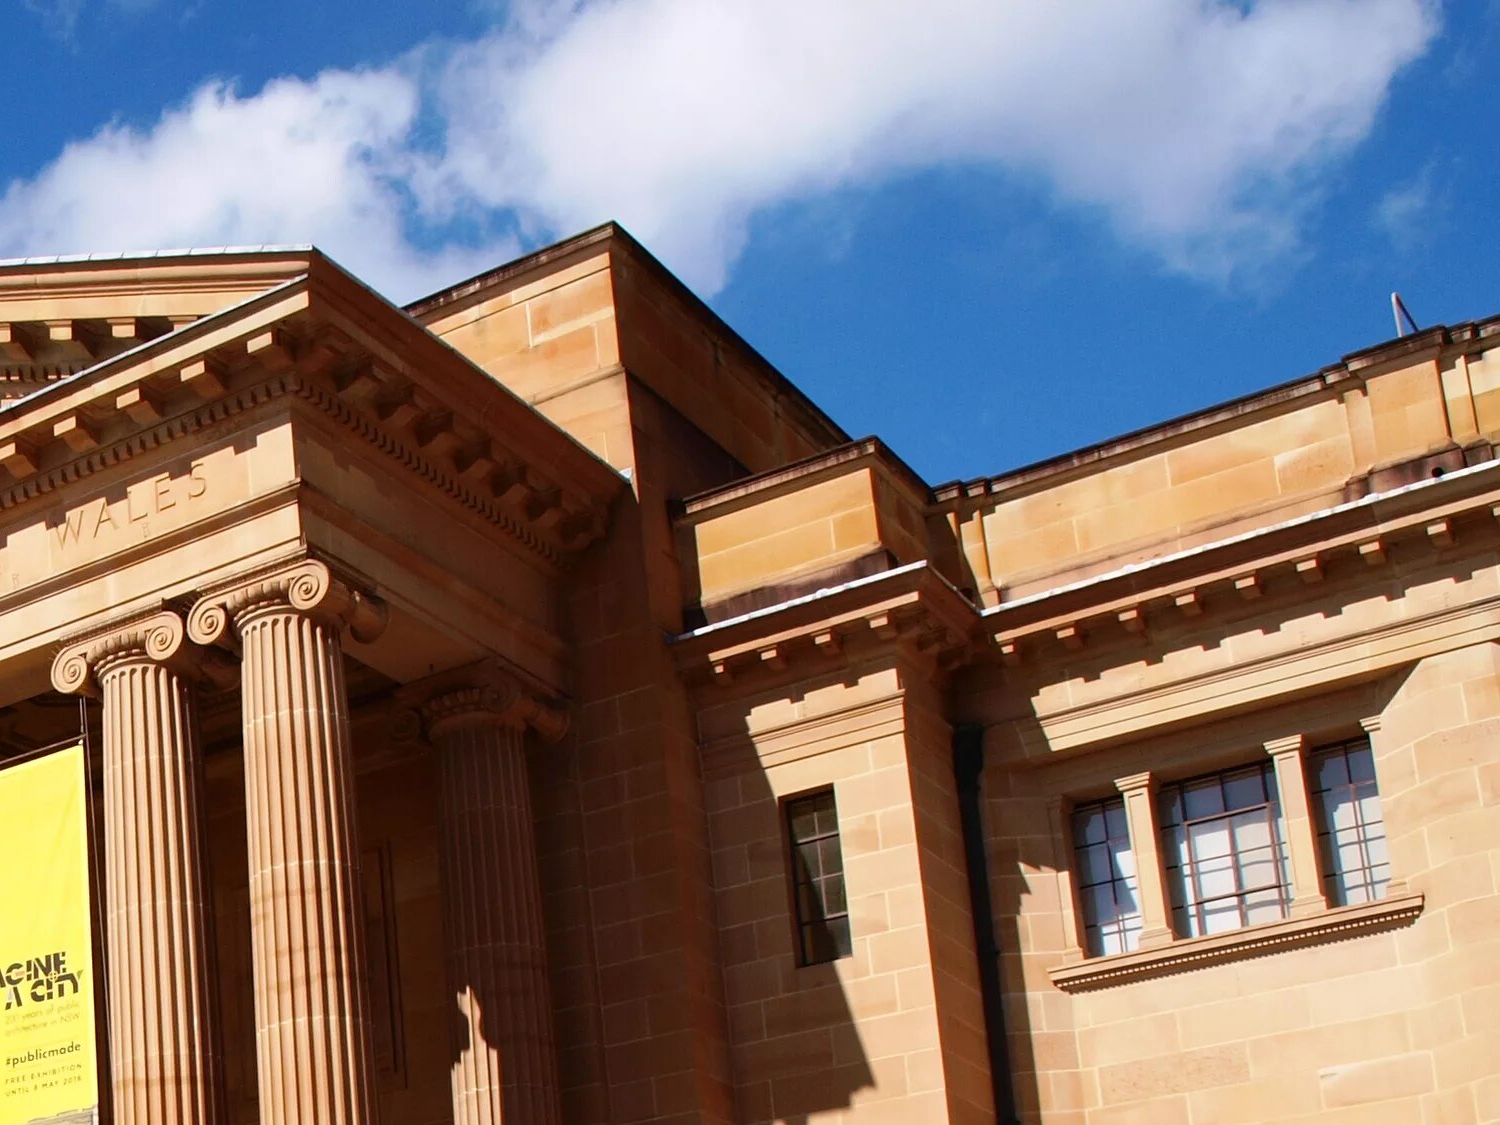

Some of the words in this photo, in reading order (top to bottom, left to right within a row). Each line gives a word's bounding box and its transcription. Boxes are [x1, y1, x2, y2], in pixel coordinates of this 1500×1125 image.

[53, 463, 207, 550] WALES
[5, 985, 22, 1010] A
[30, 969, 83, 1002] CITY
[5, 1041, 81, 1068] #publicmade
[4, 1075, 26, 1085] FREE
[30, 1063, 83, 1080] EXHIBITION
[3, 1086, 29, 1098] UNTIL
[41, 1080, 60, 1089] MAY
